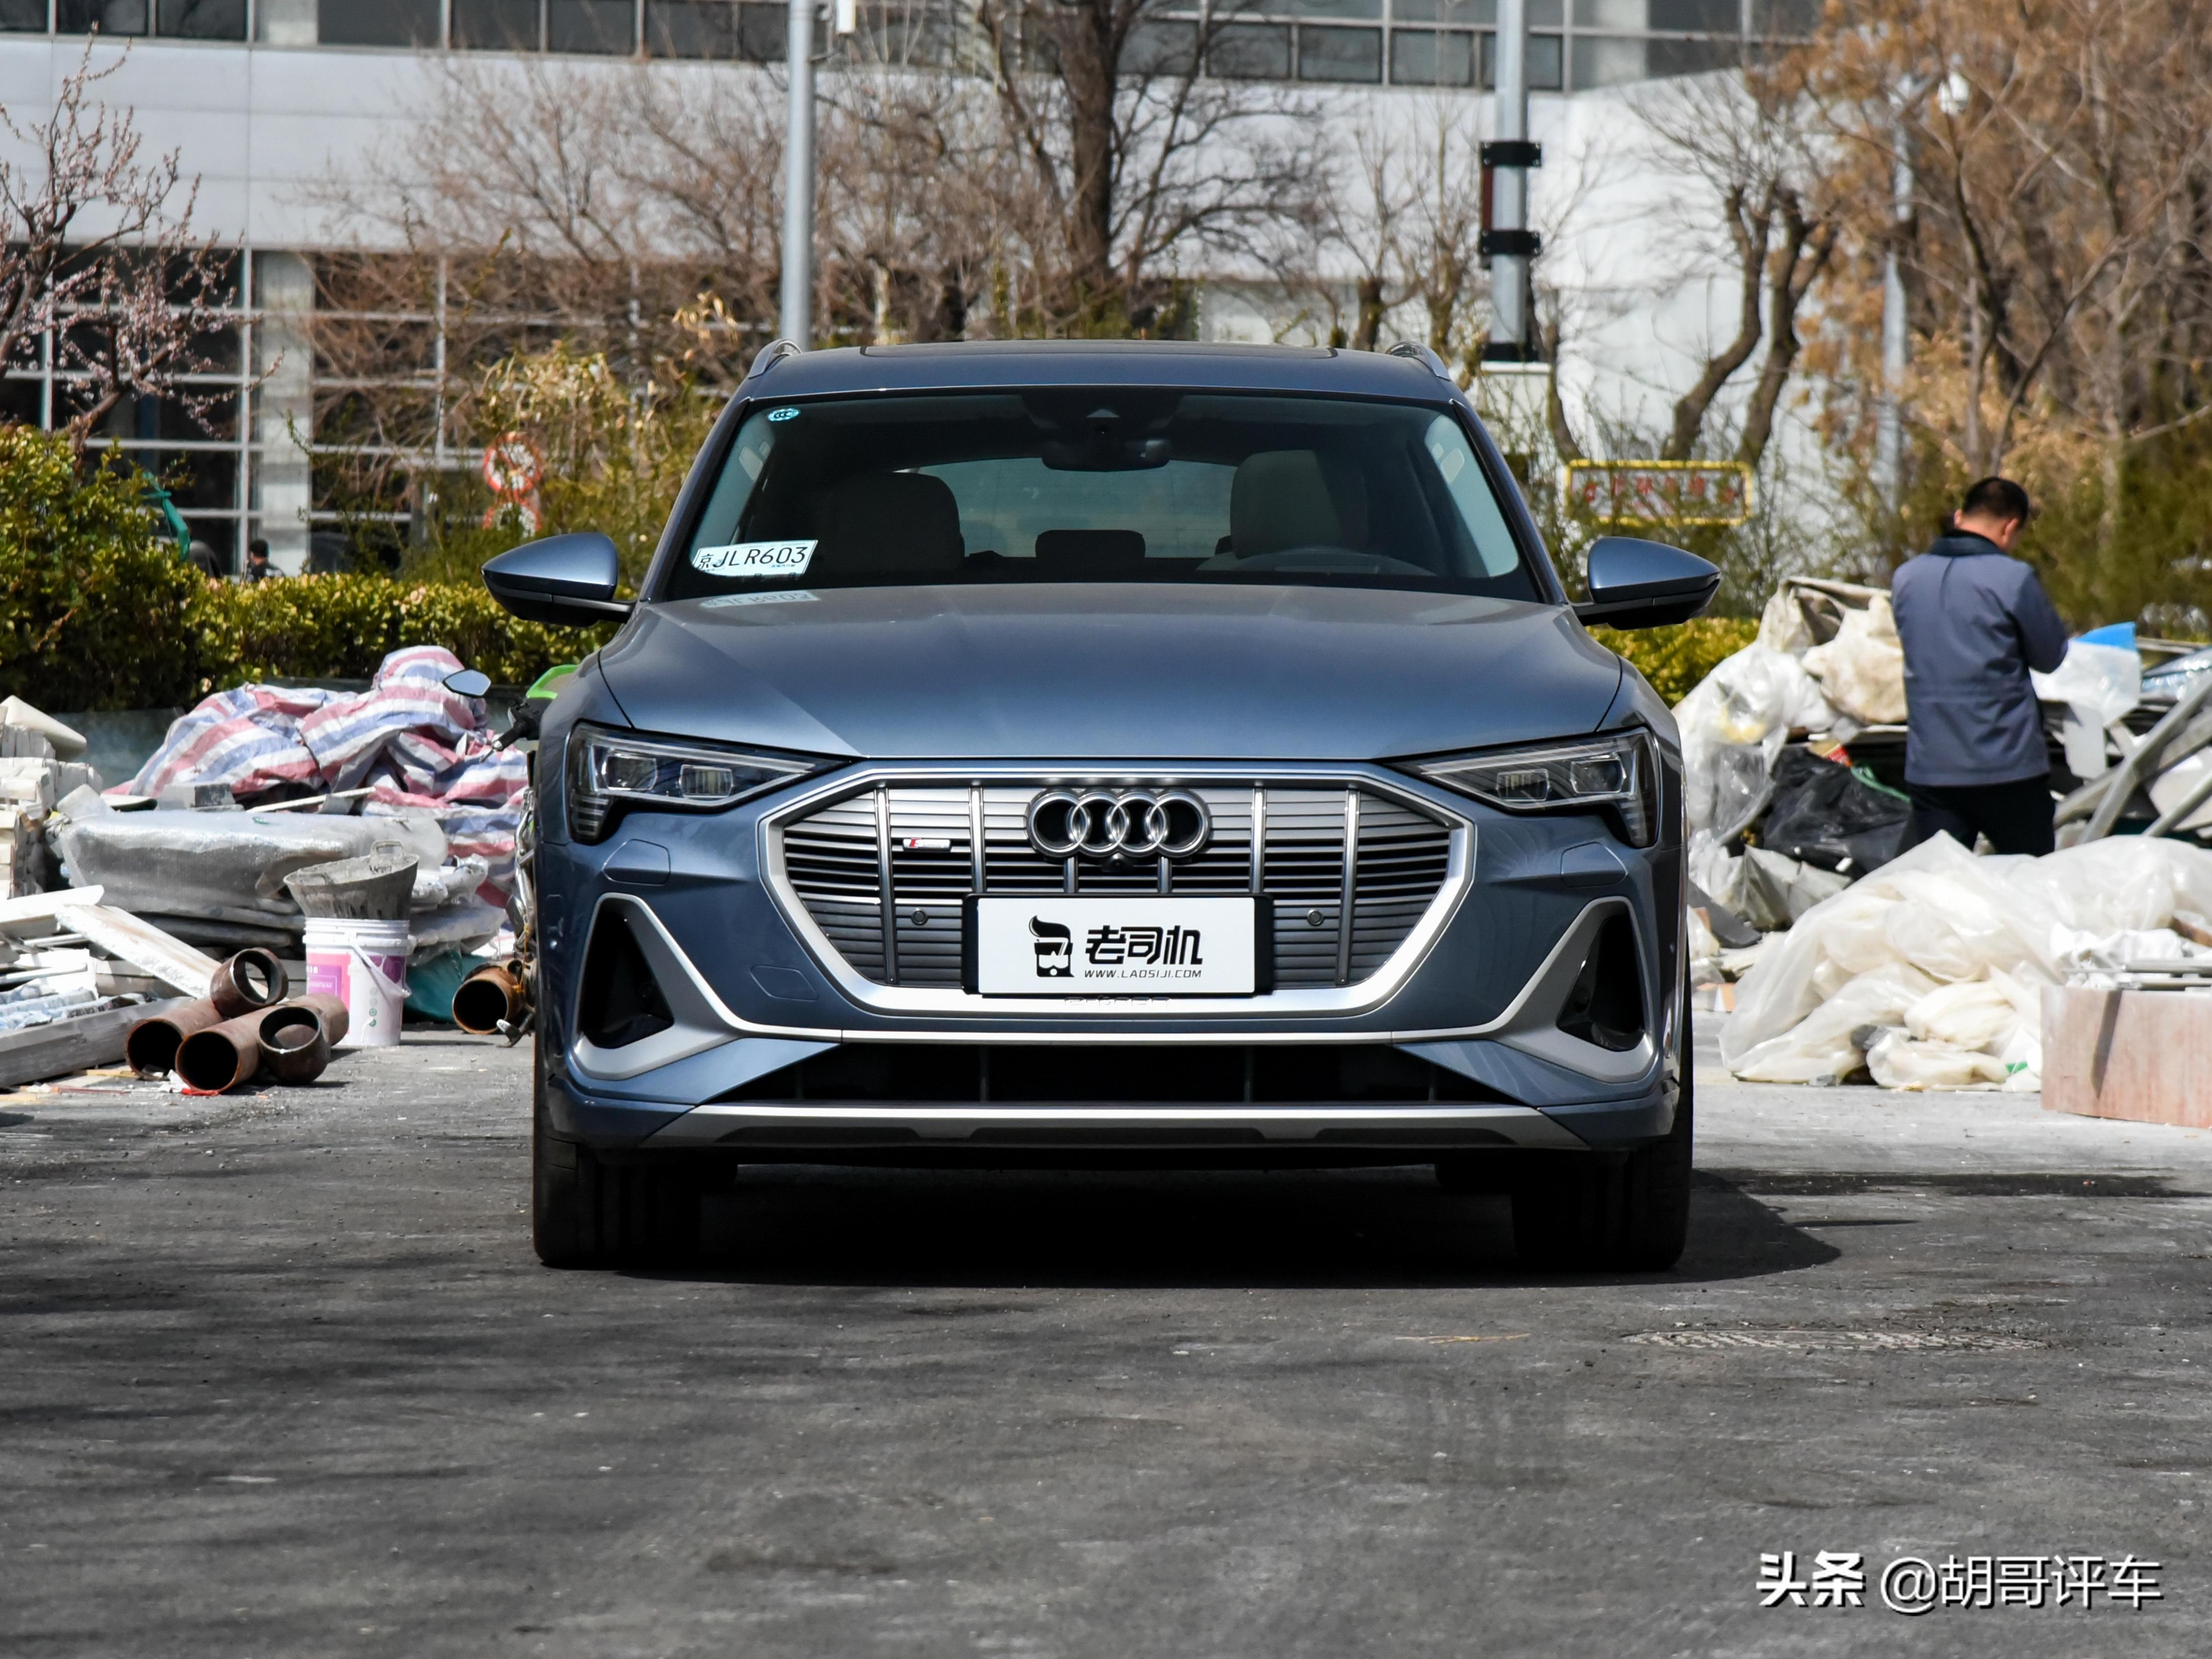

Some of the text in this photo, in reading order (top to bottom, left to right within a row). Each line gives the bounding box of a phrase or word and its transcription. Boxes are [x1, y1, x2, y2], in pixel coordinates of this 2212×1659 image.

[1085, 925, 1203, 965] 老司机
[1084, 969, 1202, 978] WWW.LAOSIJI.COM
